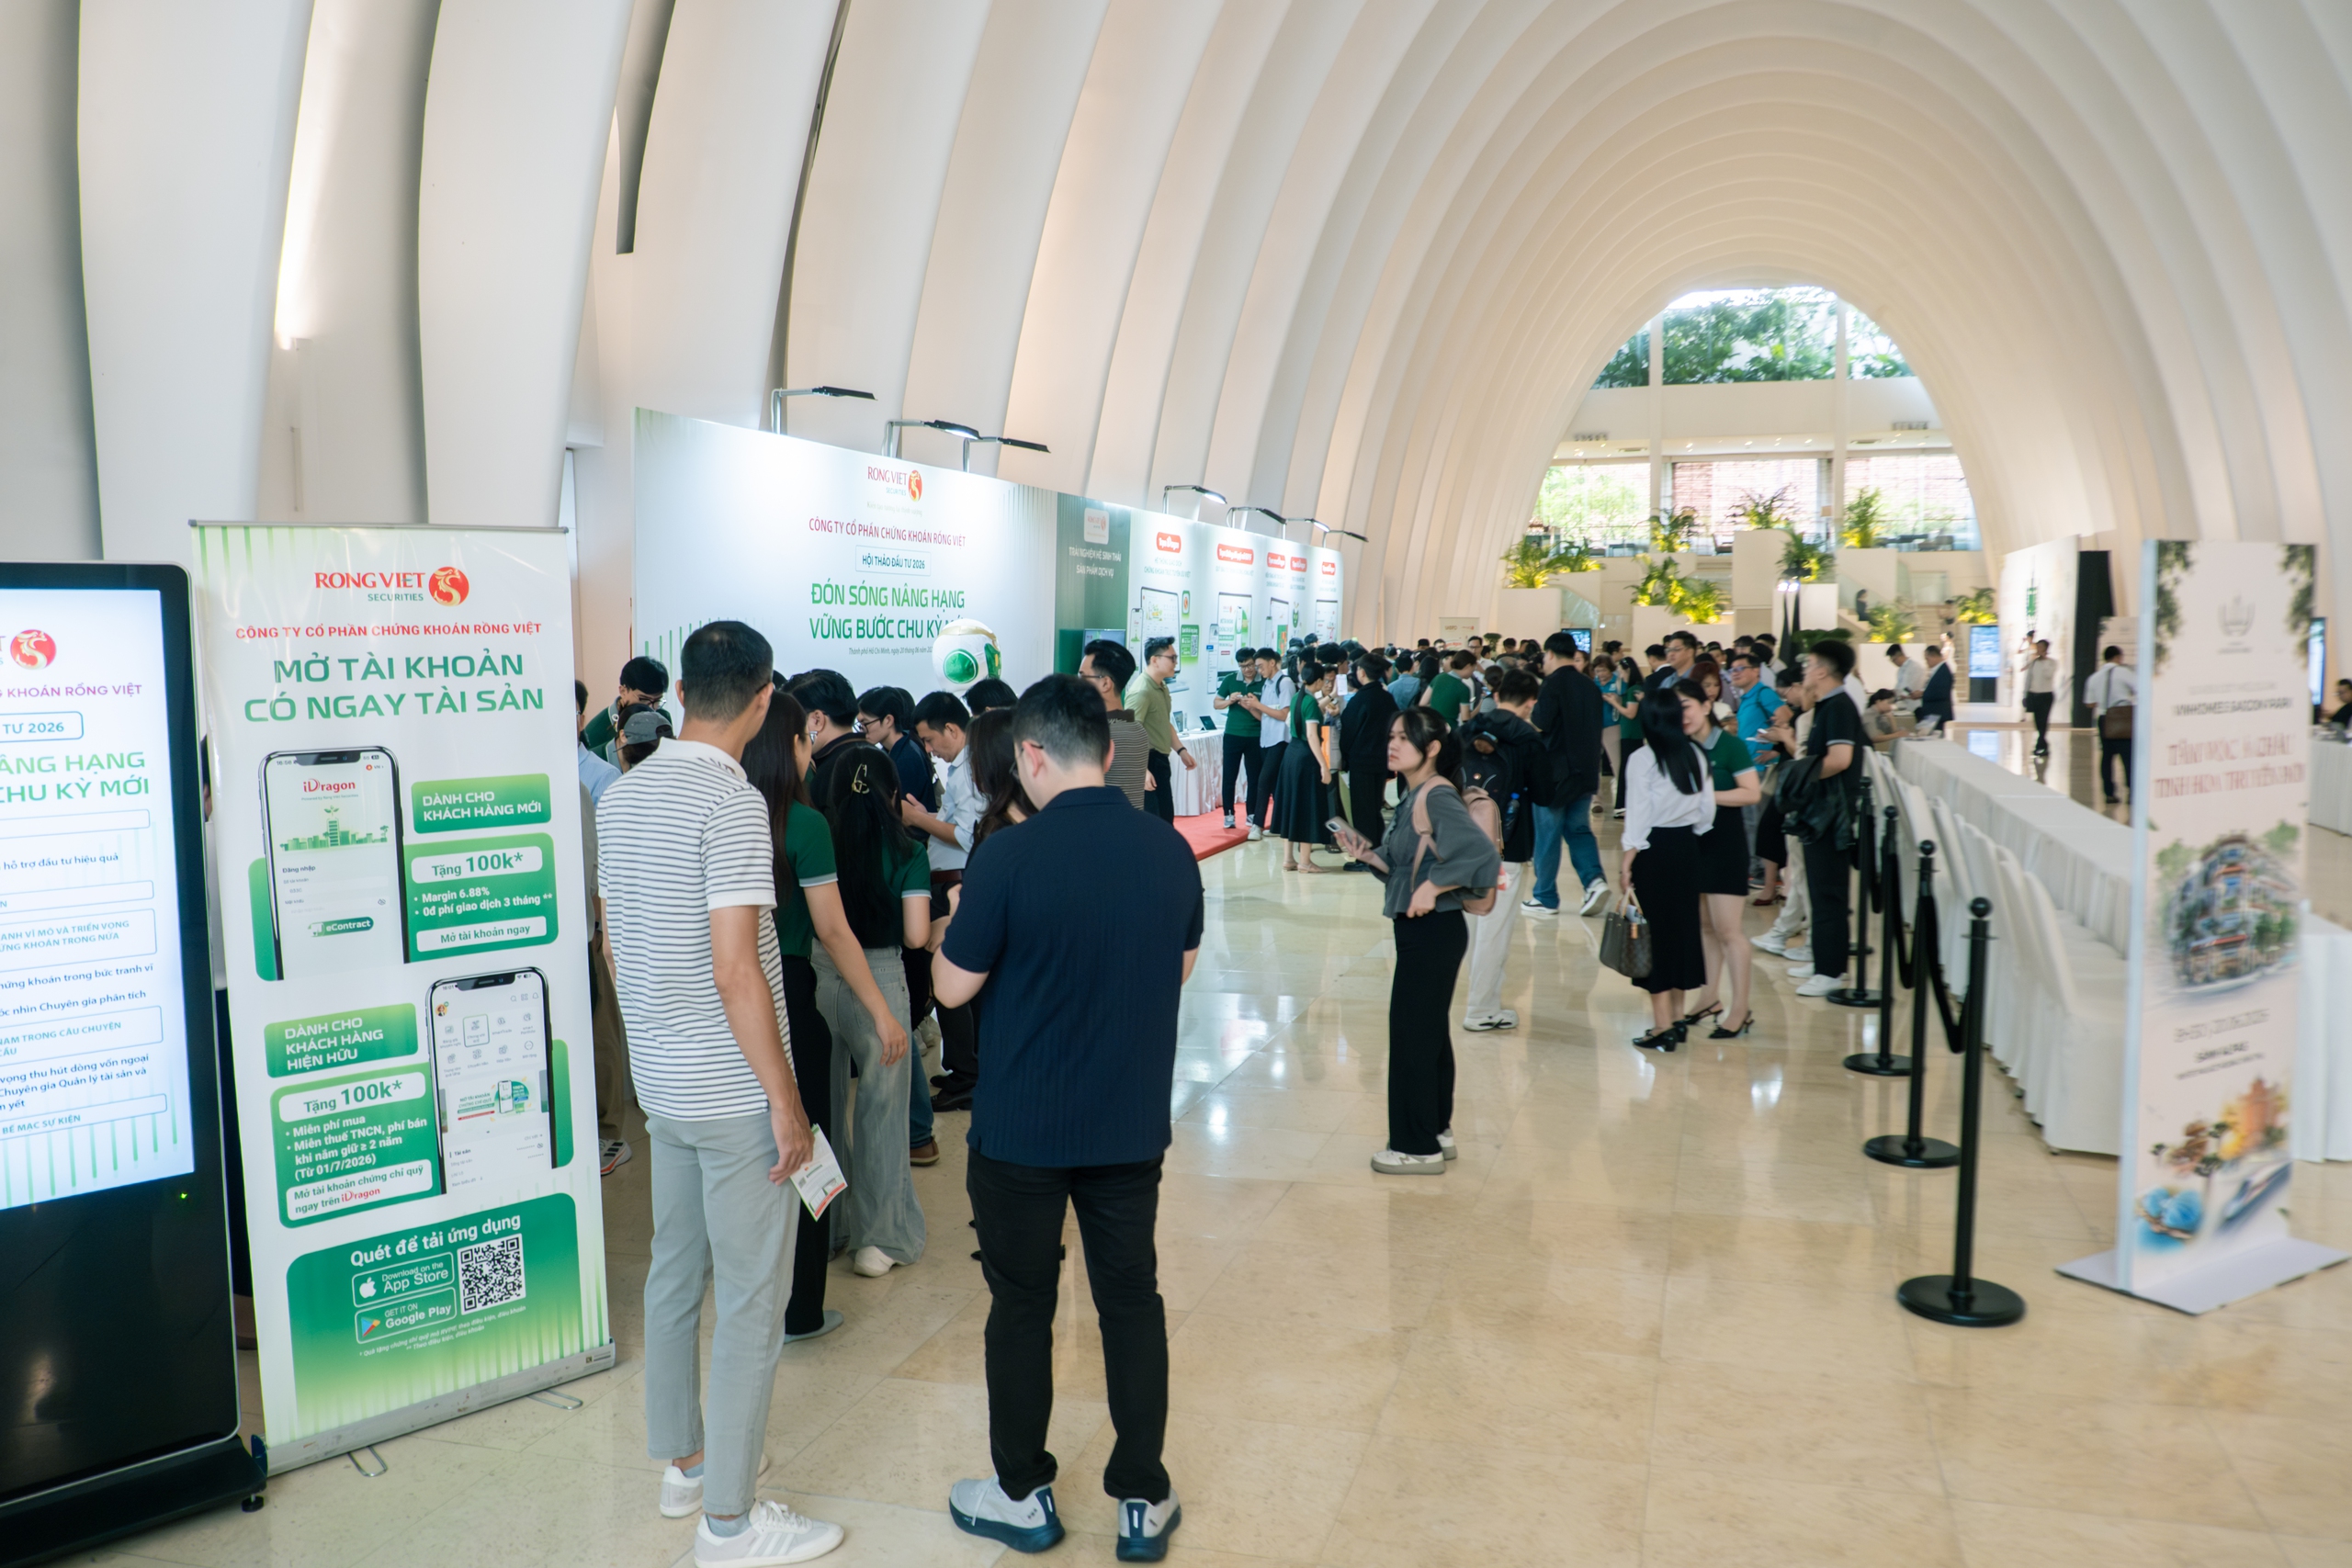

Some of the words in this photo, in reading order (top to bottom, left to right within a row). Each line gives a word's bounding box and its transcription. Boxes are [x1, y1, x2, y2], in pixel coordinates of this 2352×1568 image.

[868, 467, 889, 483] RONG
[891, 470, 907, 485] VIET
[887, 487, 906, 496] SECURITIES
[809, 516, 832, 532] CÔNG
[834, 521, 843, 534] TY
[845, 519, 856, 535] CỔ
[881, 526, 906, 541] CHỨNG
[908, 529, 933, 544] KHOÁN
[953, 534, 966, 549] VIỆT
[863, 553, 873, 568] HỘI
[875, 554, 890, 567] THẢO
[891, 555, 903, 568] ĐẦU
[905, 558, 912, 569] TƯ
[912, 559, 925, 570] 2026
[314, 572, 377, 589] RONG
[379, 572, 425, 589] VIET
[368, 592, 424, 602] SECURITIES
[811, 578, 844, 604] ĐÓN
[849, 580, 888, 606] SÓNG
[891, 583, 928, 607] NÂNG
[932, 590, 965, 613] HẠNG
[236, 626, 278, 639] CÔNG
[282, 627, 301, 637] TY
[305, 624, 325, 637] CỔ
[328, 624, 367, 637] PHẦN
[371, 624, 420, 636] CHỨNG
[424, 623, 469, 635] KHOÁN
[474, 622, 510, 635] RỒNG
[513, 622, 541, 635] VIỆT
[809, 613, 852, 638] VỮNG
[856, 614, 894, 638] BƯỚC
[898, 619, 923, 638] CHU
[927, 615, 942, 638] KỲ
[274, 652, 330, 683] MỞ
[338, 651, 394, 682] TÀI
[405, 649, 524, 680] KHOẢN
[7, 685, 61, 697] KHOÁN
[112, 682, 142, 697] VIỆT
[244, 692, 296, 722] CÓ
[307, 694, 406, 719] NGAY
[414, 686, 467, 715] TÀI
[477, 683, 544, 712] SẢN
[3, 723, 24, 734] TƯ
[28, 722, 64, 733] 2026
[65, 751, 145, 774] HẠNG
[57, 778, 92, 799] KỲ
[101, 774, 149, 797] MỚI
[303, 778, 356, 793] iDragon
[423, 793, 462, 807] DÀNH
[465, 792, 494, 803] CHO
[424, 807, 470, 821] KHÁCH
[474, 804, 514, 817] HÀNG
[517, 800, 541, 813] MỚI
[21, 861, 36, 869] trợ
[74, 855, 96, 864] hiệu
[99, 852, 119, 864] quả
[432, 864, 461, 877] Tặng
[422, 890, 457, 903] Margin
[459, 886, 490, 897] 6.88%
[423, 905, 435, 917] 0đ
[438, 904, 454, 916] phí
[456, 902, 477, 914] giao
[480, 898, 501, 910] dịch
[504, 897, 510, 907] 3
[513, 895, 540, 907] tháng
[326, 919, 370, 931] eContract
[441, 932, 456, 943] Mở
[458, 931, 471, 941] tài
[473, 928, 504, 939] khoản
[507, 925, 530, 936] ngay
[285, 1022, 328, 1039] DÀNH
[332, 1018, 363, 1032] CHO
[287, 1036, 337, 1055] KHÁCH
[341, 1029, 383, 1045] HÀNG
[0, 1072, 26, 1084] vọng
[29, 1068, 47, 1077] thu
[51, 1066, 67, 1076] hút
[71, 1062, 96, 1073] dòng
[121, 1054, 149, 1066] ngoại
[288, 1055, 323, 1070] HIỆN
[326, 1048, 357, 1064] HỮU
[304, 1099, 336, 1114] Tặng
[17, 1122, 40, 1133] MẠC
[42, 1118, 56, 1128] SỰ
[59, 1114, 81, 1124] KIỆN
[323, 1120, 340, 1132] phí
[343, 1116, 366, 1127] mua
[324, 1132, 348, 1145] thuế
[350, 1125, 385, 1139] TNCN,
[388, 1121, 405, 1134] phí
[407, 1118, 427, 1129] bán
[295, 1154, 312, 1166] khi
[341, 1144, 358, 1157] giữ
[369, 1140, 377, 1149] 2
[379, 1136, 402, 1147] năm
[295, 1167, 314, 1181] (Từ
[316, 1154, 376, 1175] 01/7/2026)
[294, 1189, 311, 1200] Mở
[312, 1185, 324, 1196] tài
[327, 1179, 355, 1192] khoản
[358, 1173, 387, 1186] chứng
[390, 1168, 404, 1179] chỉ
[406, 1165, 424, 1176] quỹ
[295, 1201, 318, 1213] ngay
[322, 1197, 340, 1208] trên
[341, 1189, 380, 1202] iDragon
[350, 1244, 391, 1267] Quét
[395, 1235, 418, 1256] để
[422, 1231, 444, 1250] tải
[447, 1225, 478, 1243] ứng
[482, 1215, 521, 1235] dụng
[382, 1267, 419, 1281] Download
[432, 1261, 444, 1269] the
[383, 1277, 409, 1293] App
[413, 1269, 448, 1285] Store
[385, 1307, 398, 1318] GET
[400, 1305, 407, 1314] IT
[408, 1303, 418, 1312] ON
[385, 1311, 424, 1328] Google
[428, 1304, 451, 1318] Play
